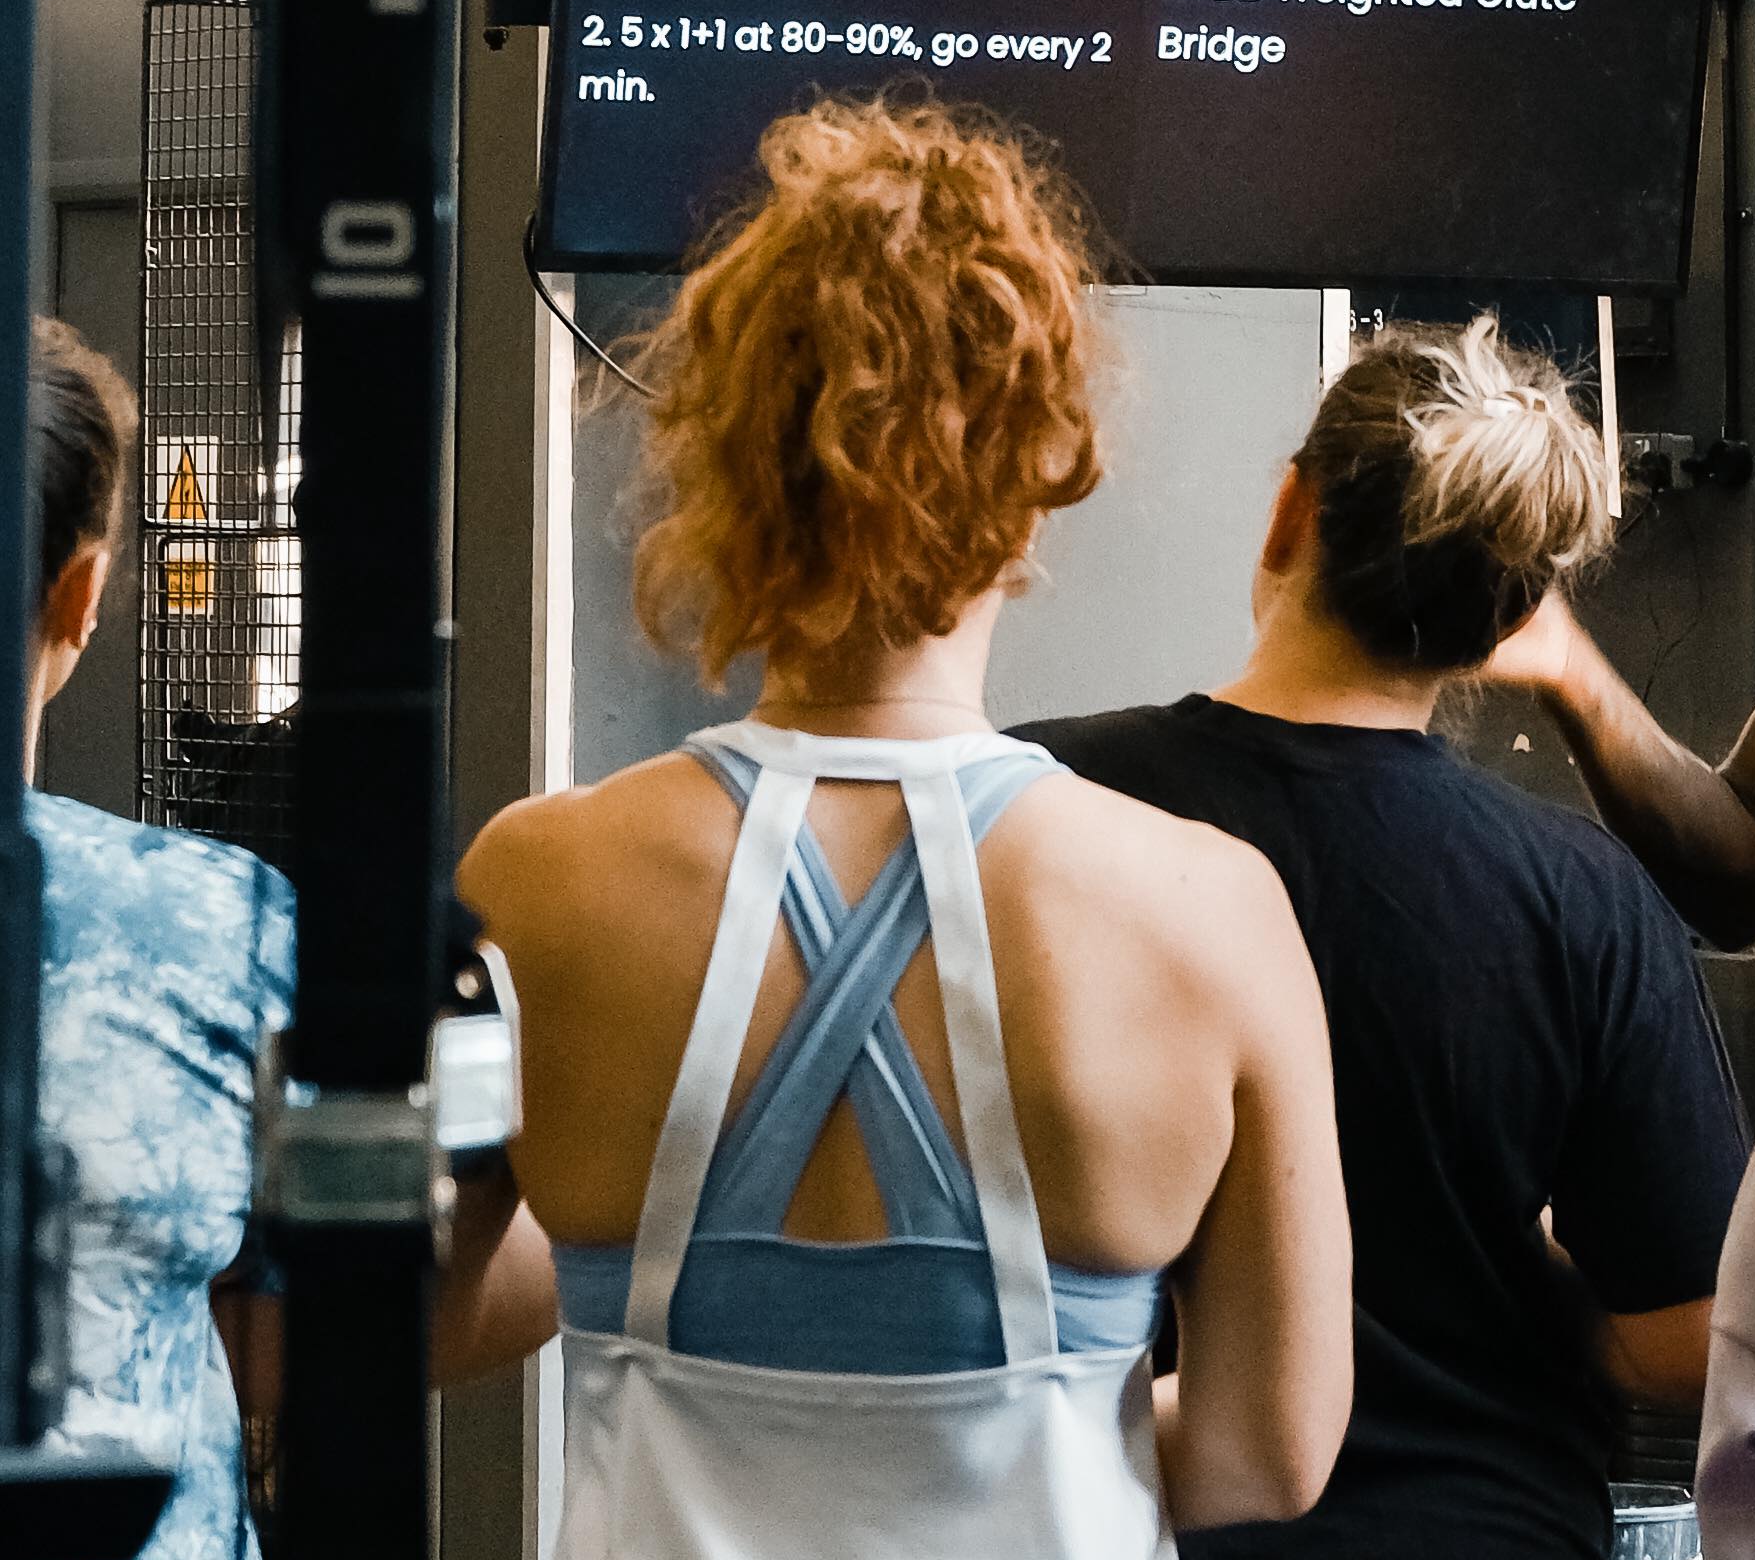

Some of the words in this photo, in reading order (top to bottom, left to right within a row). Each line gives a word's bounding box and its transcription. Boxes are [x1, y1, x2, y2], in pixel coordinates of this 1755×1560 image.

[582, 15, 611, 46] 2.
[621, 16, 643, 47] 5
[651, 24, 671, 48] x
[679, 18, 725, 50] 1+1
[735, 22, 773, 51] at
[932, 33, 978, 66] go
[987, 35, 1084, 69] every
[1091, 32, 1111, 61] 2
[1158, 25, 1285, 72] Bridge
[579, 69, 655, 101] min.
